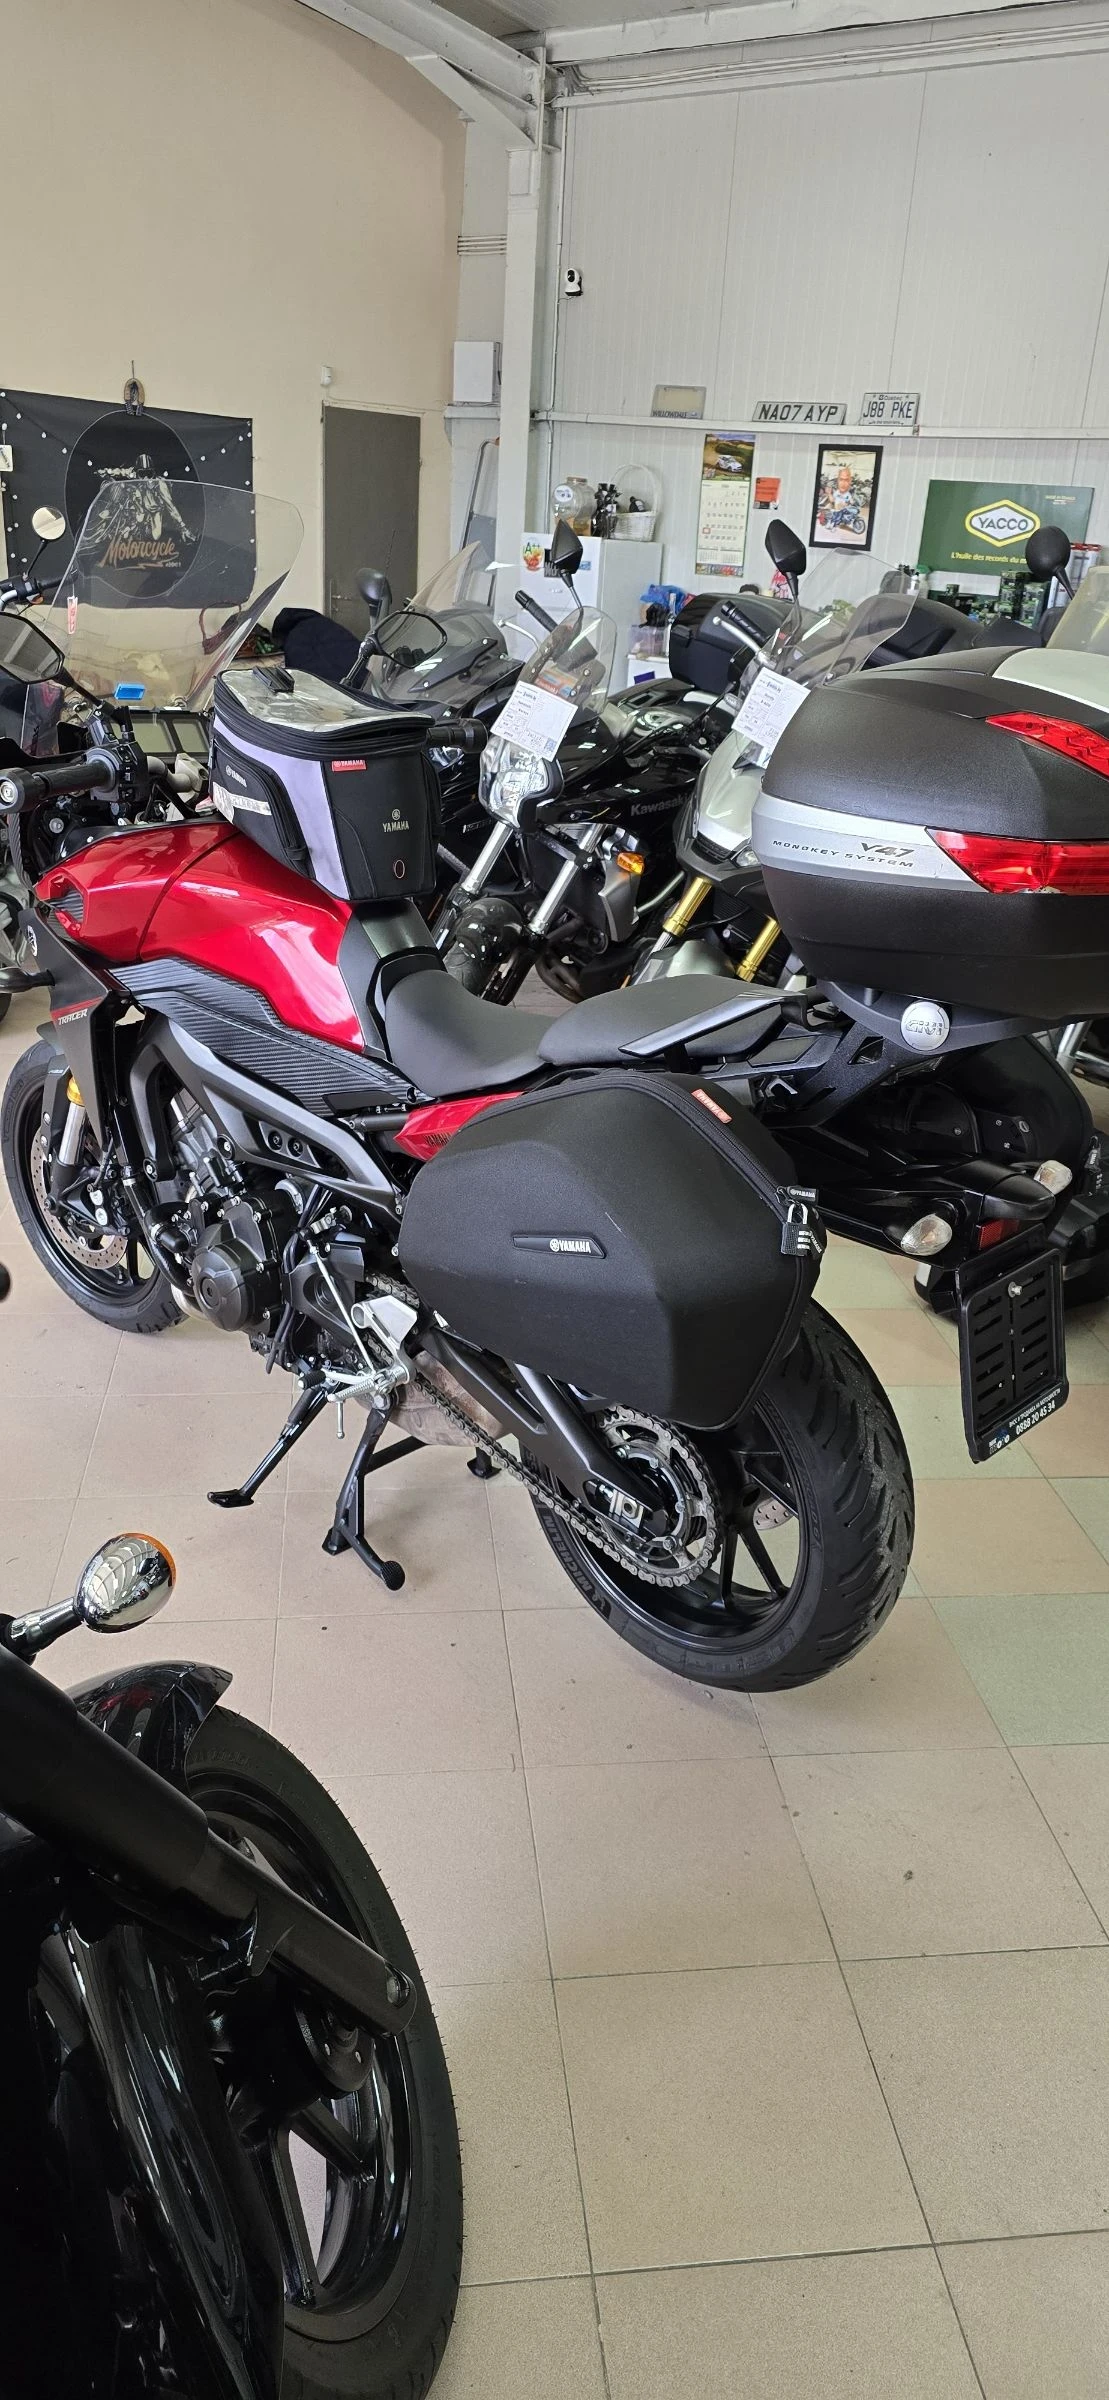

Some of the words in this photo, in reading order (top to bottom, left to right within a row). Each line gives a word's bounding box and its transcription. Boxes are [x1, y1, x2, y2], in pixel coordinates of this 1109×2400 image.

[758, 404, 802, 421] NA07
[804, 405, 838, 422] AYP
[863, 401, 885, 418] J88
[891, 401, 915, 419] PKE
[978, 517, 1028, 531] YACCO
[100, 538, 179, 568] Motorcycle
[973, 553, 984, 561] des
[1009, 556, 1019, 564] du
[340, 759, 364, 767] YAMAHA
[382, 820, 410, 833] YAMAHA
[772, 840, 839, 856] MONOKEY
[845, 853, 914, 868] SYSTEM
[861, 842, 915, 858] V47
[58, 1008, 88, 1026] TRACER
[906, 1020, 943, 1036] GIVI
[796, 1189, 816, 1198] YAMAHA
[559, 1239, 591, 1254] YAMAHA
[1016, 1418, 1031, 1435] 0888
[1031, 1411, 1040, 1424] 20
[1040, 1406, 1047, 1418] 45
[1047, 1400, 1056, 1413] 34
[542, 1514, 593, 1592] MICHELIN
